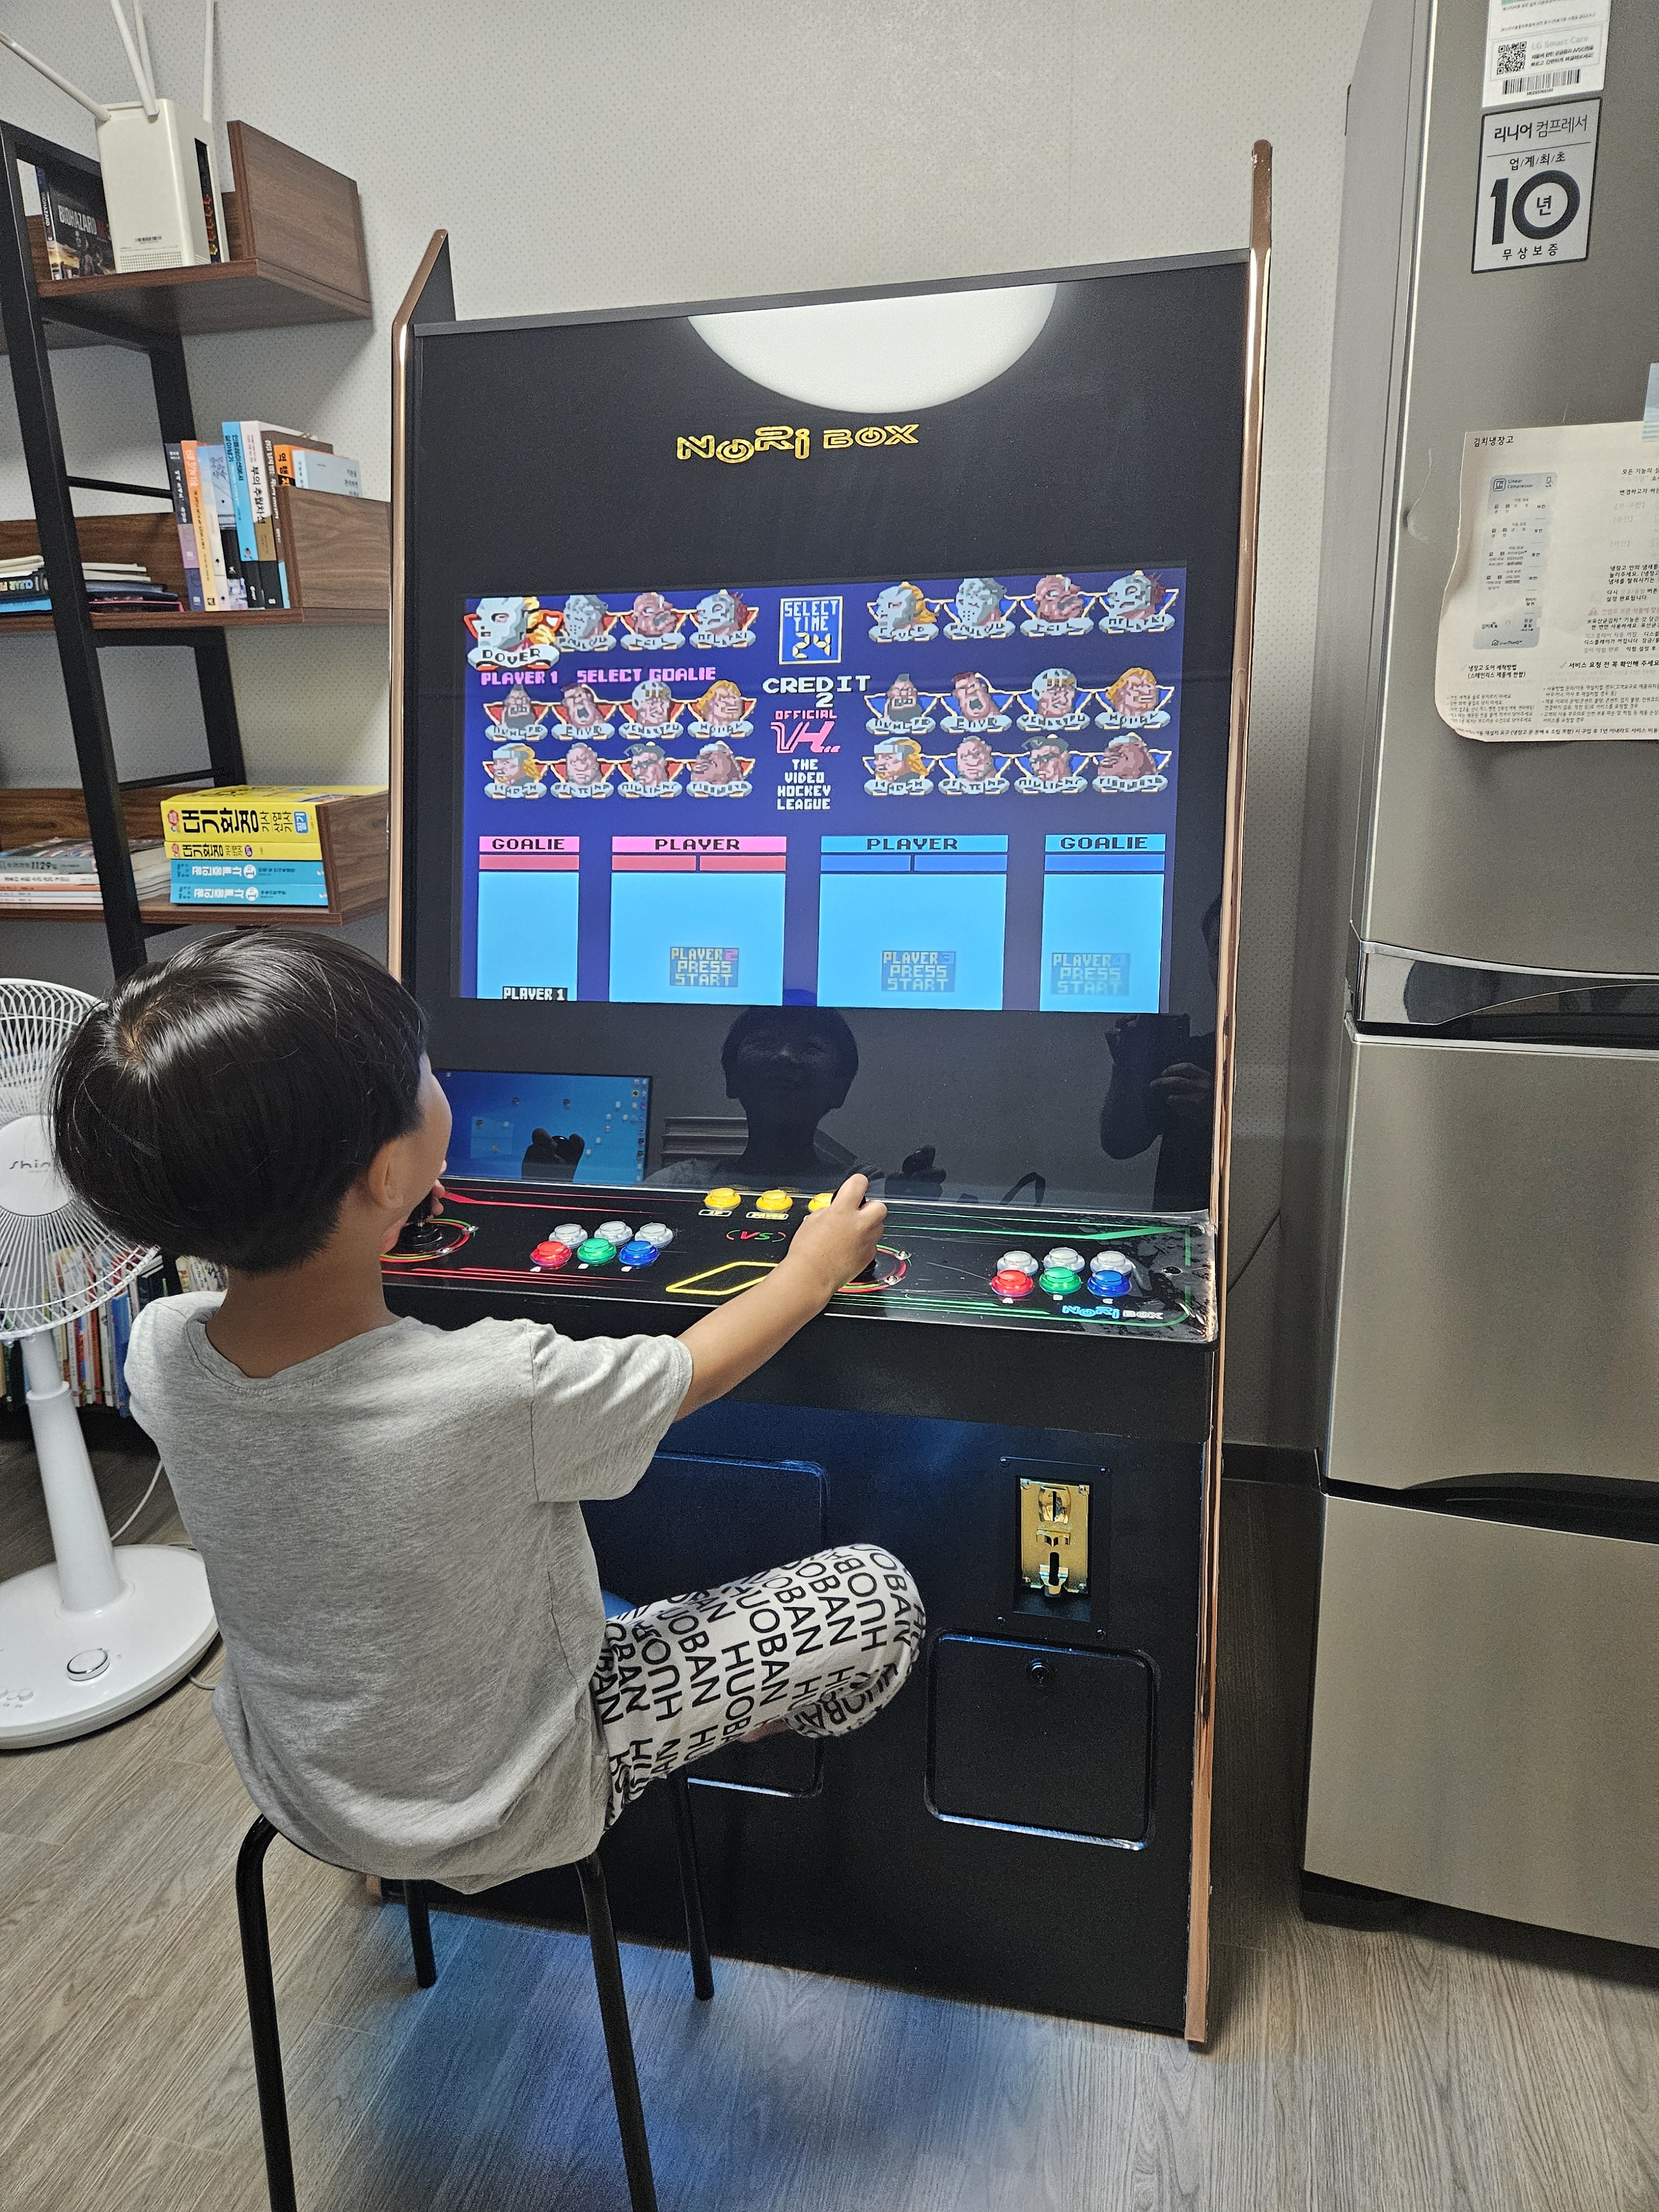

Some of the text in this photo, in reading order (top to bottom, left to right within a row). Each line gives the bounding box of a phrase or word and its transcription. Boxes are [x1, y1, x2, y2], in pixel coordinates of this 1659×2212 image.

[1494, 114, 1588, 143] 리니어 컴프레서
[1490, 170, 1580, 245] 10
[1537, 195, 1552, 216] 년
[58, 205, 97, 235] BIOHAZARD
[823, 424, 920, 450] BOX
[1474, 436, 1514, 447] 김치냉장고
[251, 466, 266, 524] 부의 추월차선
[784, 600, 838, 617] SELECT
[793, 616, 829, 632] TIME
[792, 632, 831, 659] 24
[482, 648, 541, 665] DOVER
[481, 666, 716, 685] PLAYER 1 SELECT GOALIE
[762, 675, 871, 693] CREDIT
[815, 692, 834, 708] 2
[775, 709, 838, 720] OFFICIAL
[792, 759, 818, 770] THE
[784, 771, 825, 784] VIDEO
[777, 785, 831, 797] HOCKEY
[777, 797, 831, 811] LEAGUE
[181, 807, 259, 833] 대기환경
[260, 811, 269, 832] 기사
[295, 811, 308, 833] 필기
[182, 843, 223, 857] 대기환경
[492, 838, 565, 851] GOALIE
[655, 838, 740, 851] PLAYER
[866, 838, 958, 851] PLAYER
[1060, 836, 1149, 850] GOALIE
[192, 865, 242, 876] 공인중개사
[194, 888, 244, 899] 공인중개사
[671, 948, 738, 961] PLAYER 2
[883, 951, 938, 965] PLAYER
[1052, 953, 1111, 968] PLAYER
[676, 961, 732, 974] PRESS
[889, 965, 947, 978] PRESS
[1059, 967, 1121, 981] PRESS
[675, 973, 733, 987] START
[886, 978, 949, 992] START
[503, 988, 565, 1001] PLAYER 1
[1057, 980, 1123, 995] START
[1123, 1310, 1164, 1319] BOX
